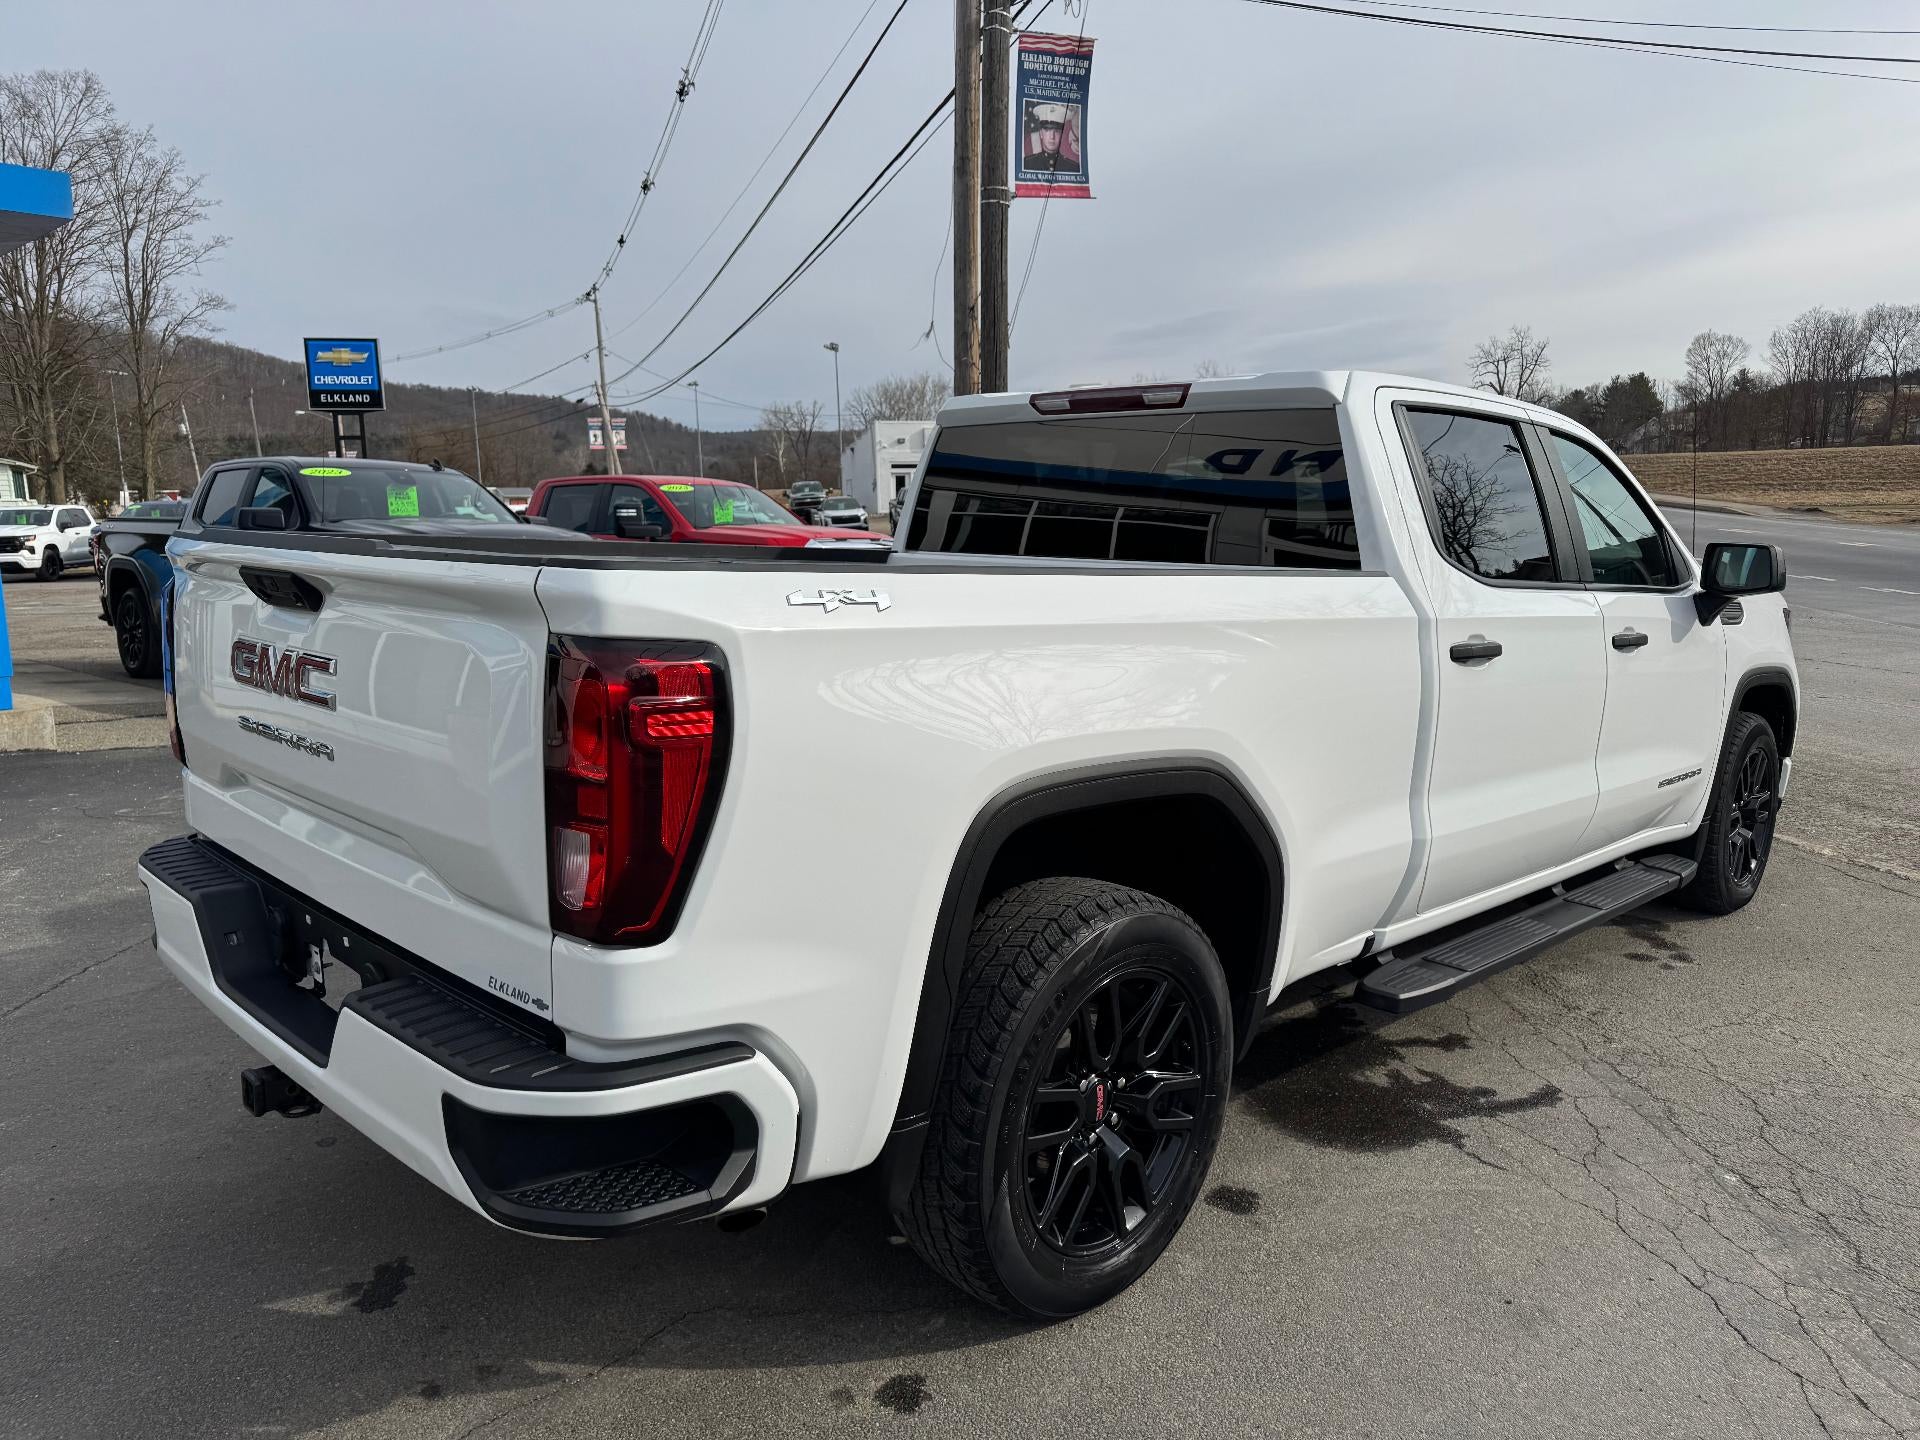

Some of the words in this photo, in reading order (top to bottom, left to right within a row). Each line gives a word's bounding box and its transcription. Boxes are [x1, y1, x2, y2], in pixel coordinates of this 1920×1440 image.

[1021, 52, 1052, 64] ELKLAND
[1054, 56, 1089, 68] BOROUGH
[1023, 61, 1064, 74] HOMETOWN
[1065, 66, 1086, 75] HERO
[1029, 78, 1057, 88] MICHAEL
[1036, 88, 1061, 98] MARINE
[1061, 91, 1081, 100] CORPS
[314, 375, 374, 385] CHEVROLET
[320, 393, 371, 403] ELKLAND
[230, 639, 338, 713] GMC
[237, 715, 335, 762] SIERRA
[1657, 767, 1702, 789] SIERRA
[488, 975, 530, 1004] ELKLAND
